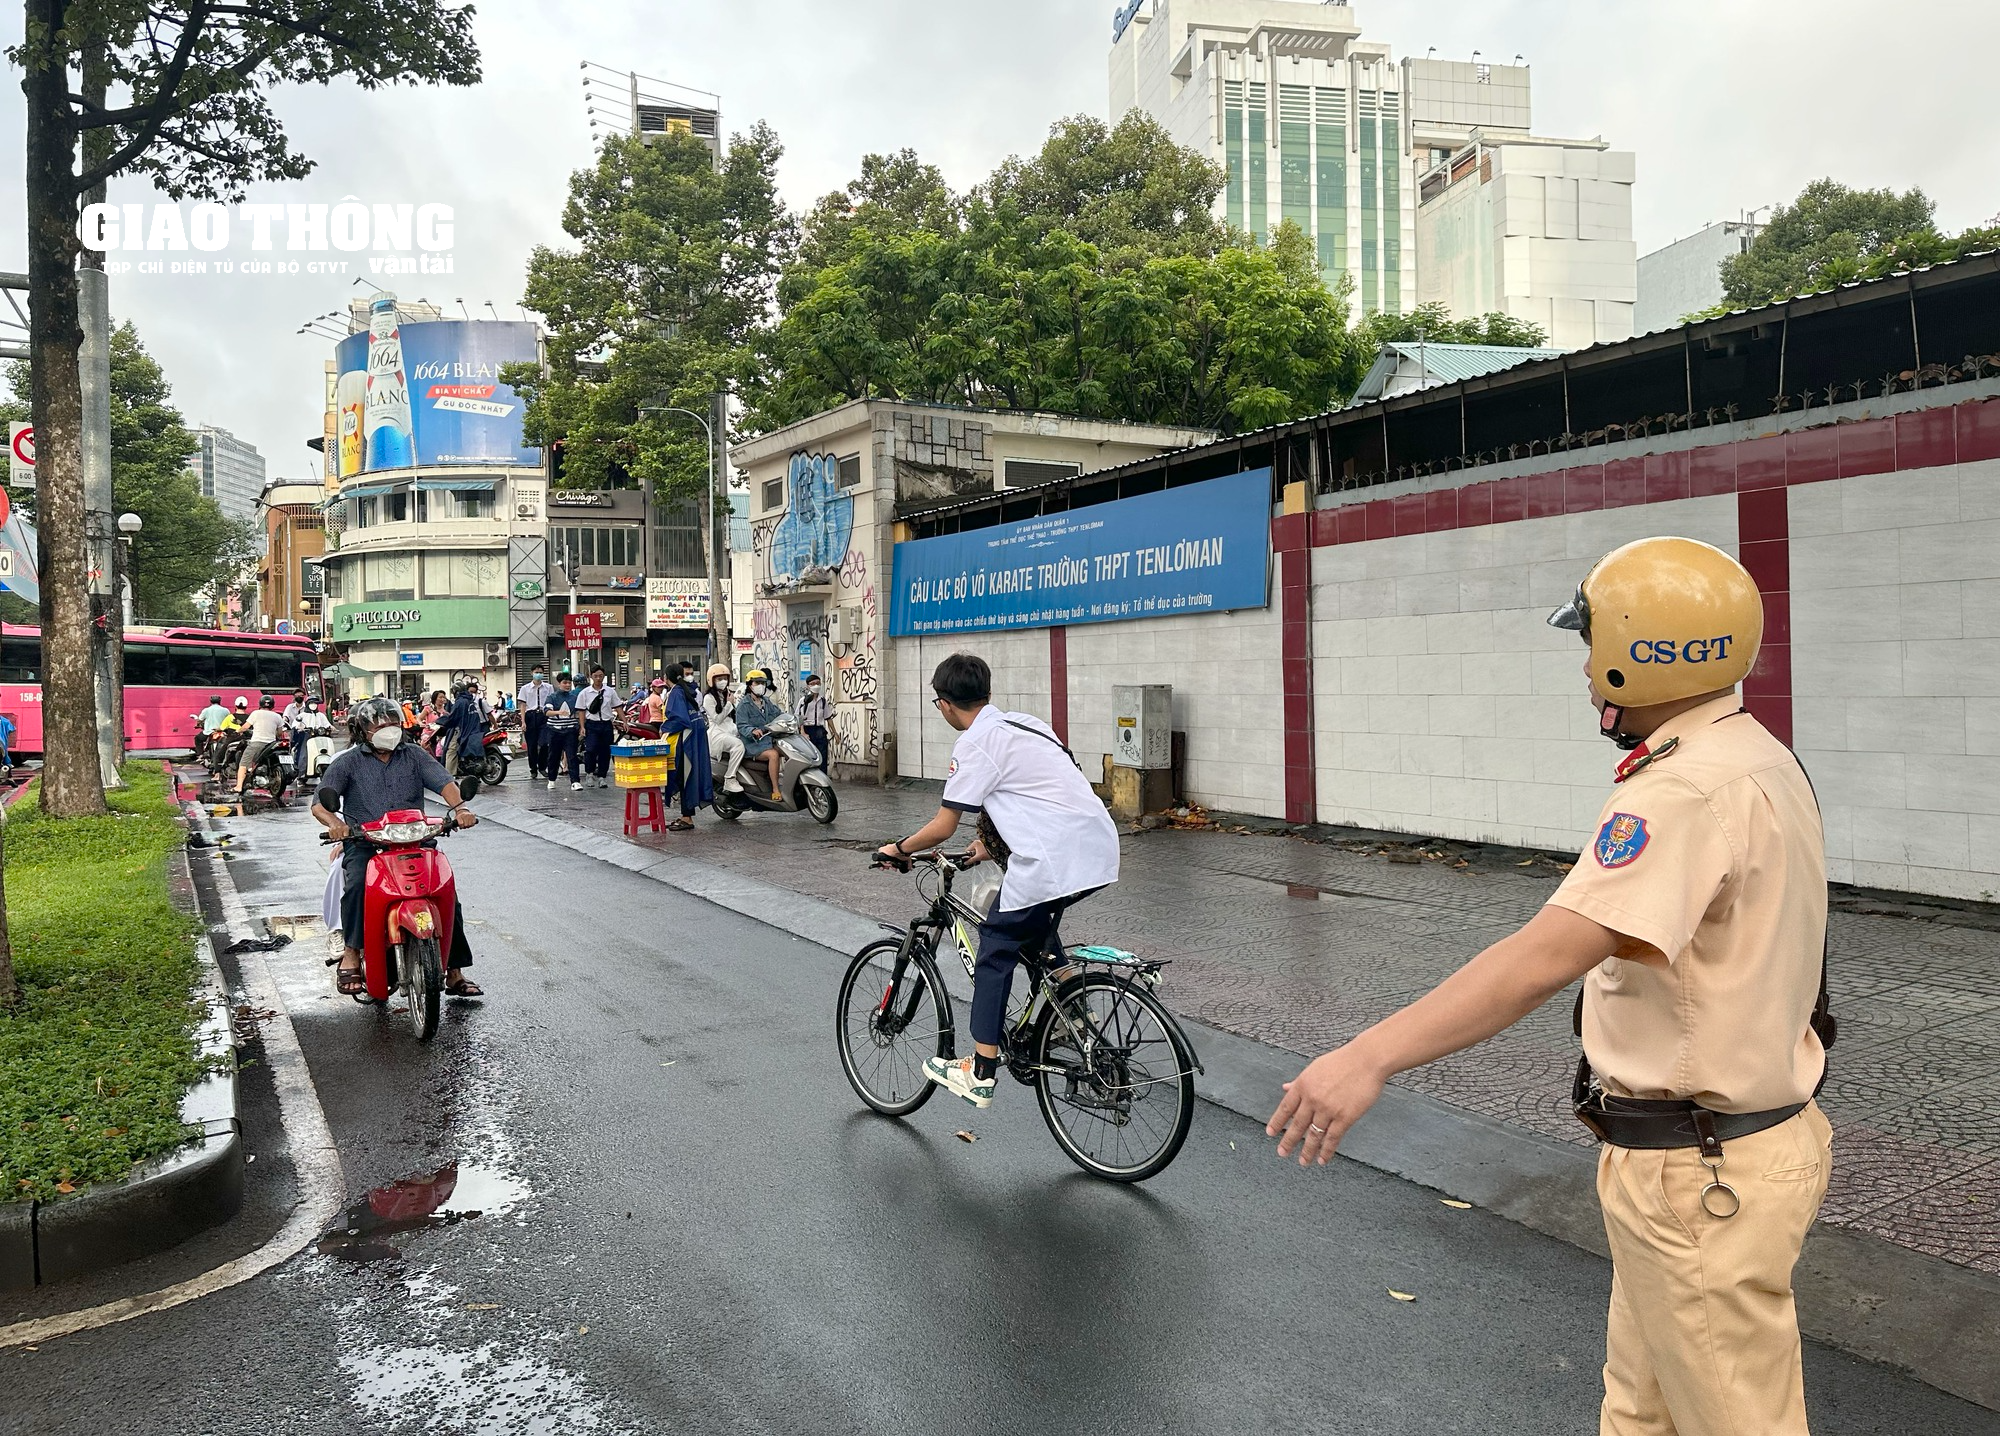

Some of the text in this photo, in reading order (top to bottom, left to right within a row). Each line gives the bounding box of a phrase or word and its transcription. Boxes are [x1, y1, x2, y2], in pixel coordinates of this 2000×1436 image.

[370, 346, 399, 370] 1664
[414, 360, 507, 380] 1664 BLAN
[366, 388, 408, 410] BLANC
[910, 576, 930, 604] CÂU
[932, 578, 951, 605] LẠC
[954, 570, 967, 603] BỘ
[972, 568, 985, 598] VÕ
[989, 566, 1034, 595] KARATE
[1038, 555, 1088, 589] TRƯỜNG
[1094, 552, 1130, 582] THPT
[1136, 536, 1223, 576] TENLƠMAN
[649, 580, 700, 593] PHƯƠNG
[384, 610, 420, 622] LONG
[964, 616, 973, 627] các
[1008, 613, 1014, 623] và
[1016, 612, 1028, 624] sáng
[1030, 609, 1040, 621] chủ
[1041, 609, 1054, 621] nhật
[1056, 608, 1069, 620] hàng
[1091, 604, 1101, 616] Nơi
[1104, 602, 1119, 616] đăng
[1134, 597, 1142, 611] Tổ
[1144, 595, 1156, 610] thể
[1158, 597, 1170, 611] dục
[1172, 594, 1186, 608] của
[1188, 592, 1212, 606] trường
[576, 615, 590, 626] CẤM
[588, 637, 600, 647] BÁN
[1630, 635, 1734, 664] CSGT
